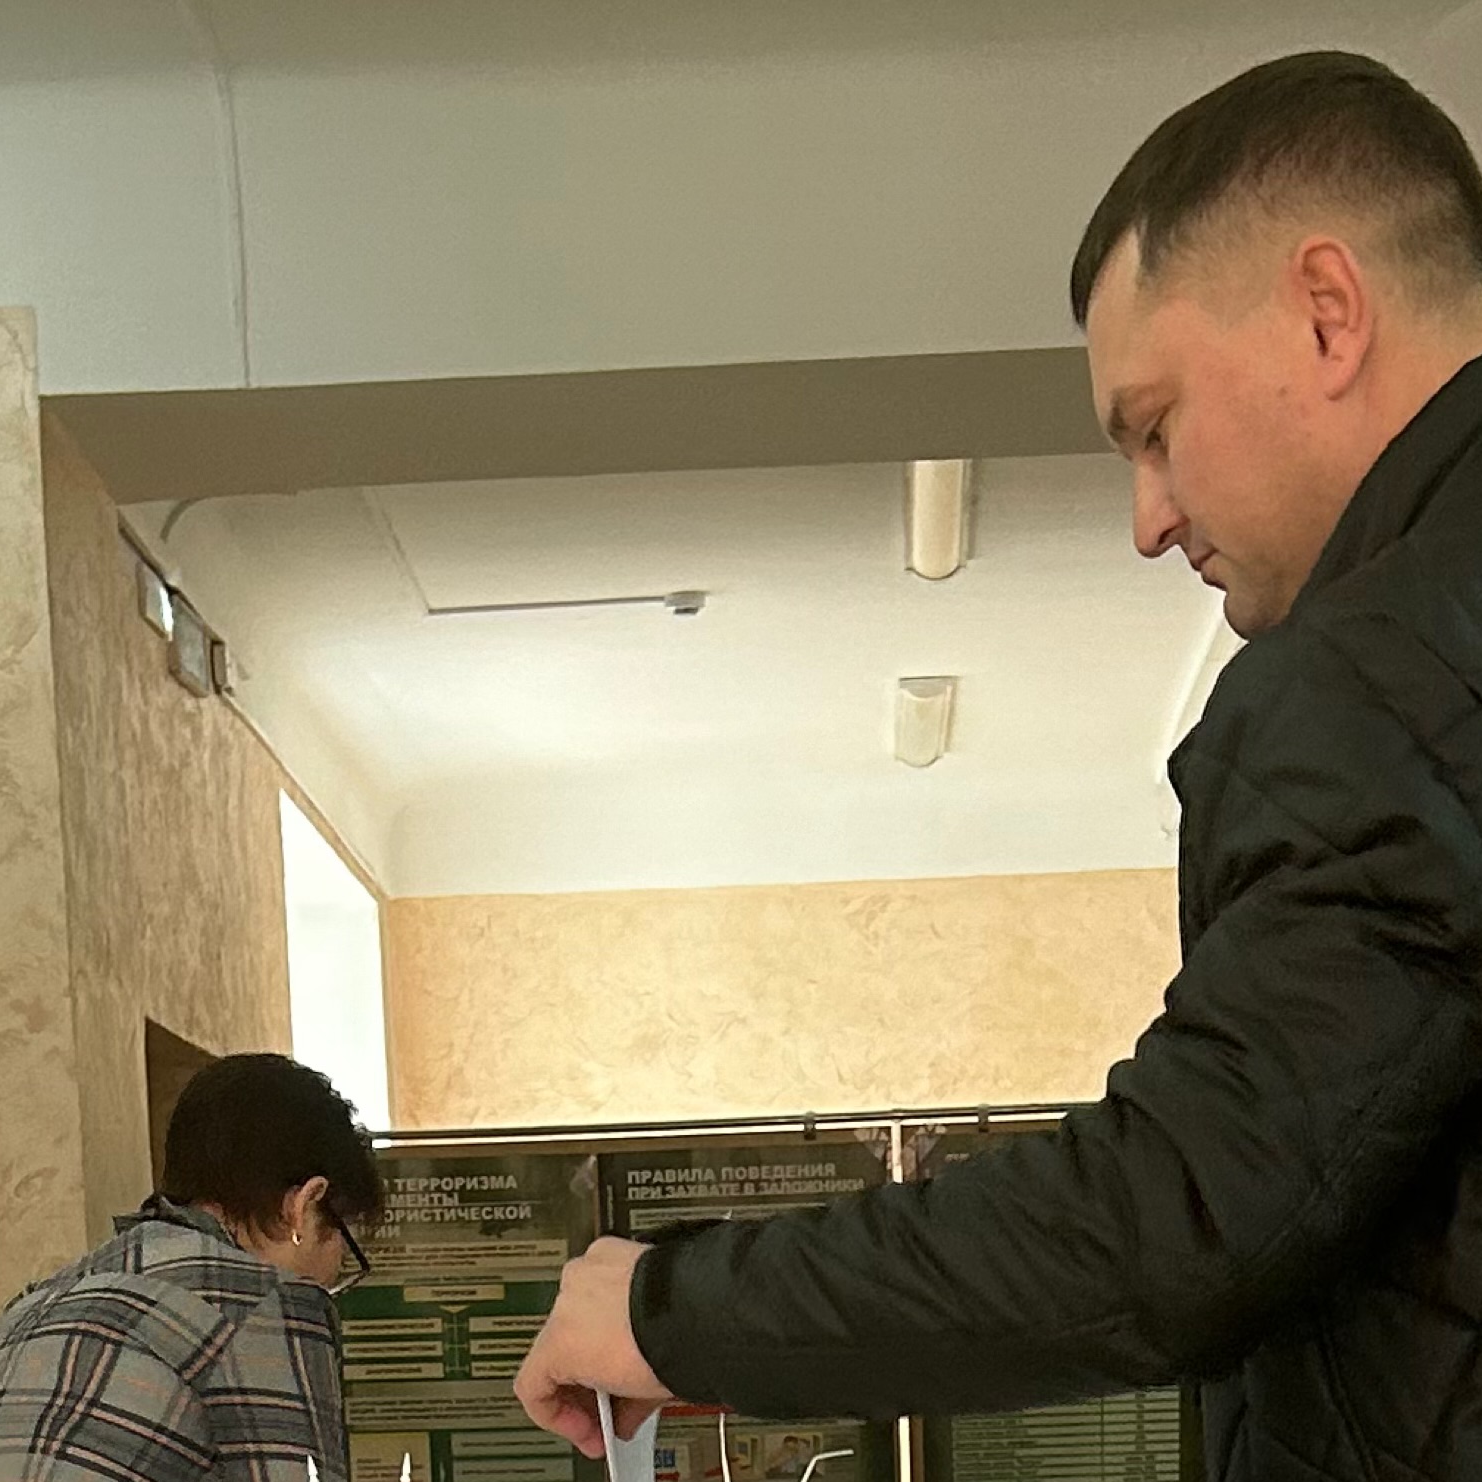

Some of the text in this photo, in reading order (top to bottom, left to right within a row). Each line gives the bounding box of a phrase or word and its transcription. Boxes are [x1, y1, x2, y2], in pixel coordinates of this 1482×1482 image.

[627, 1163, 836, 1184] ПРАВИЛА ПОВЕДЕНИЯ
[394, 1175, 517, 1192] ТЕРРОРИЗМА
[627, 1185, 661, 1200] ПРИ
